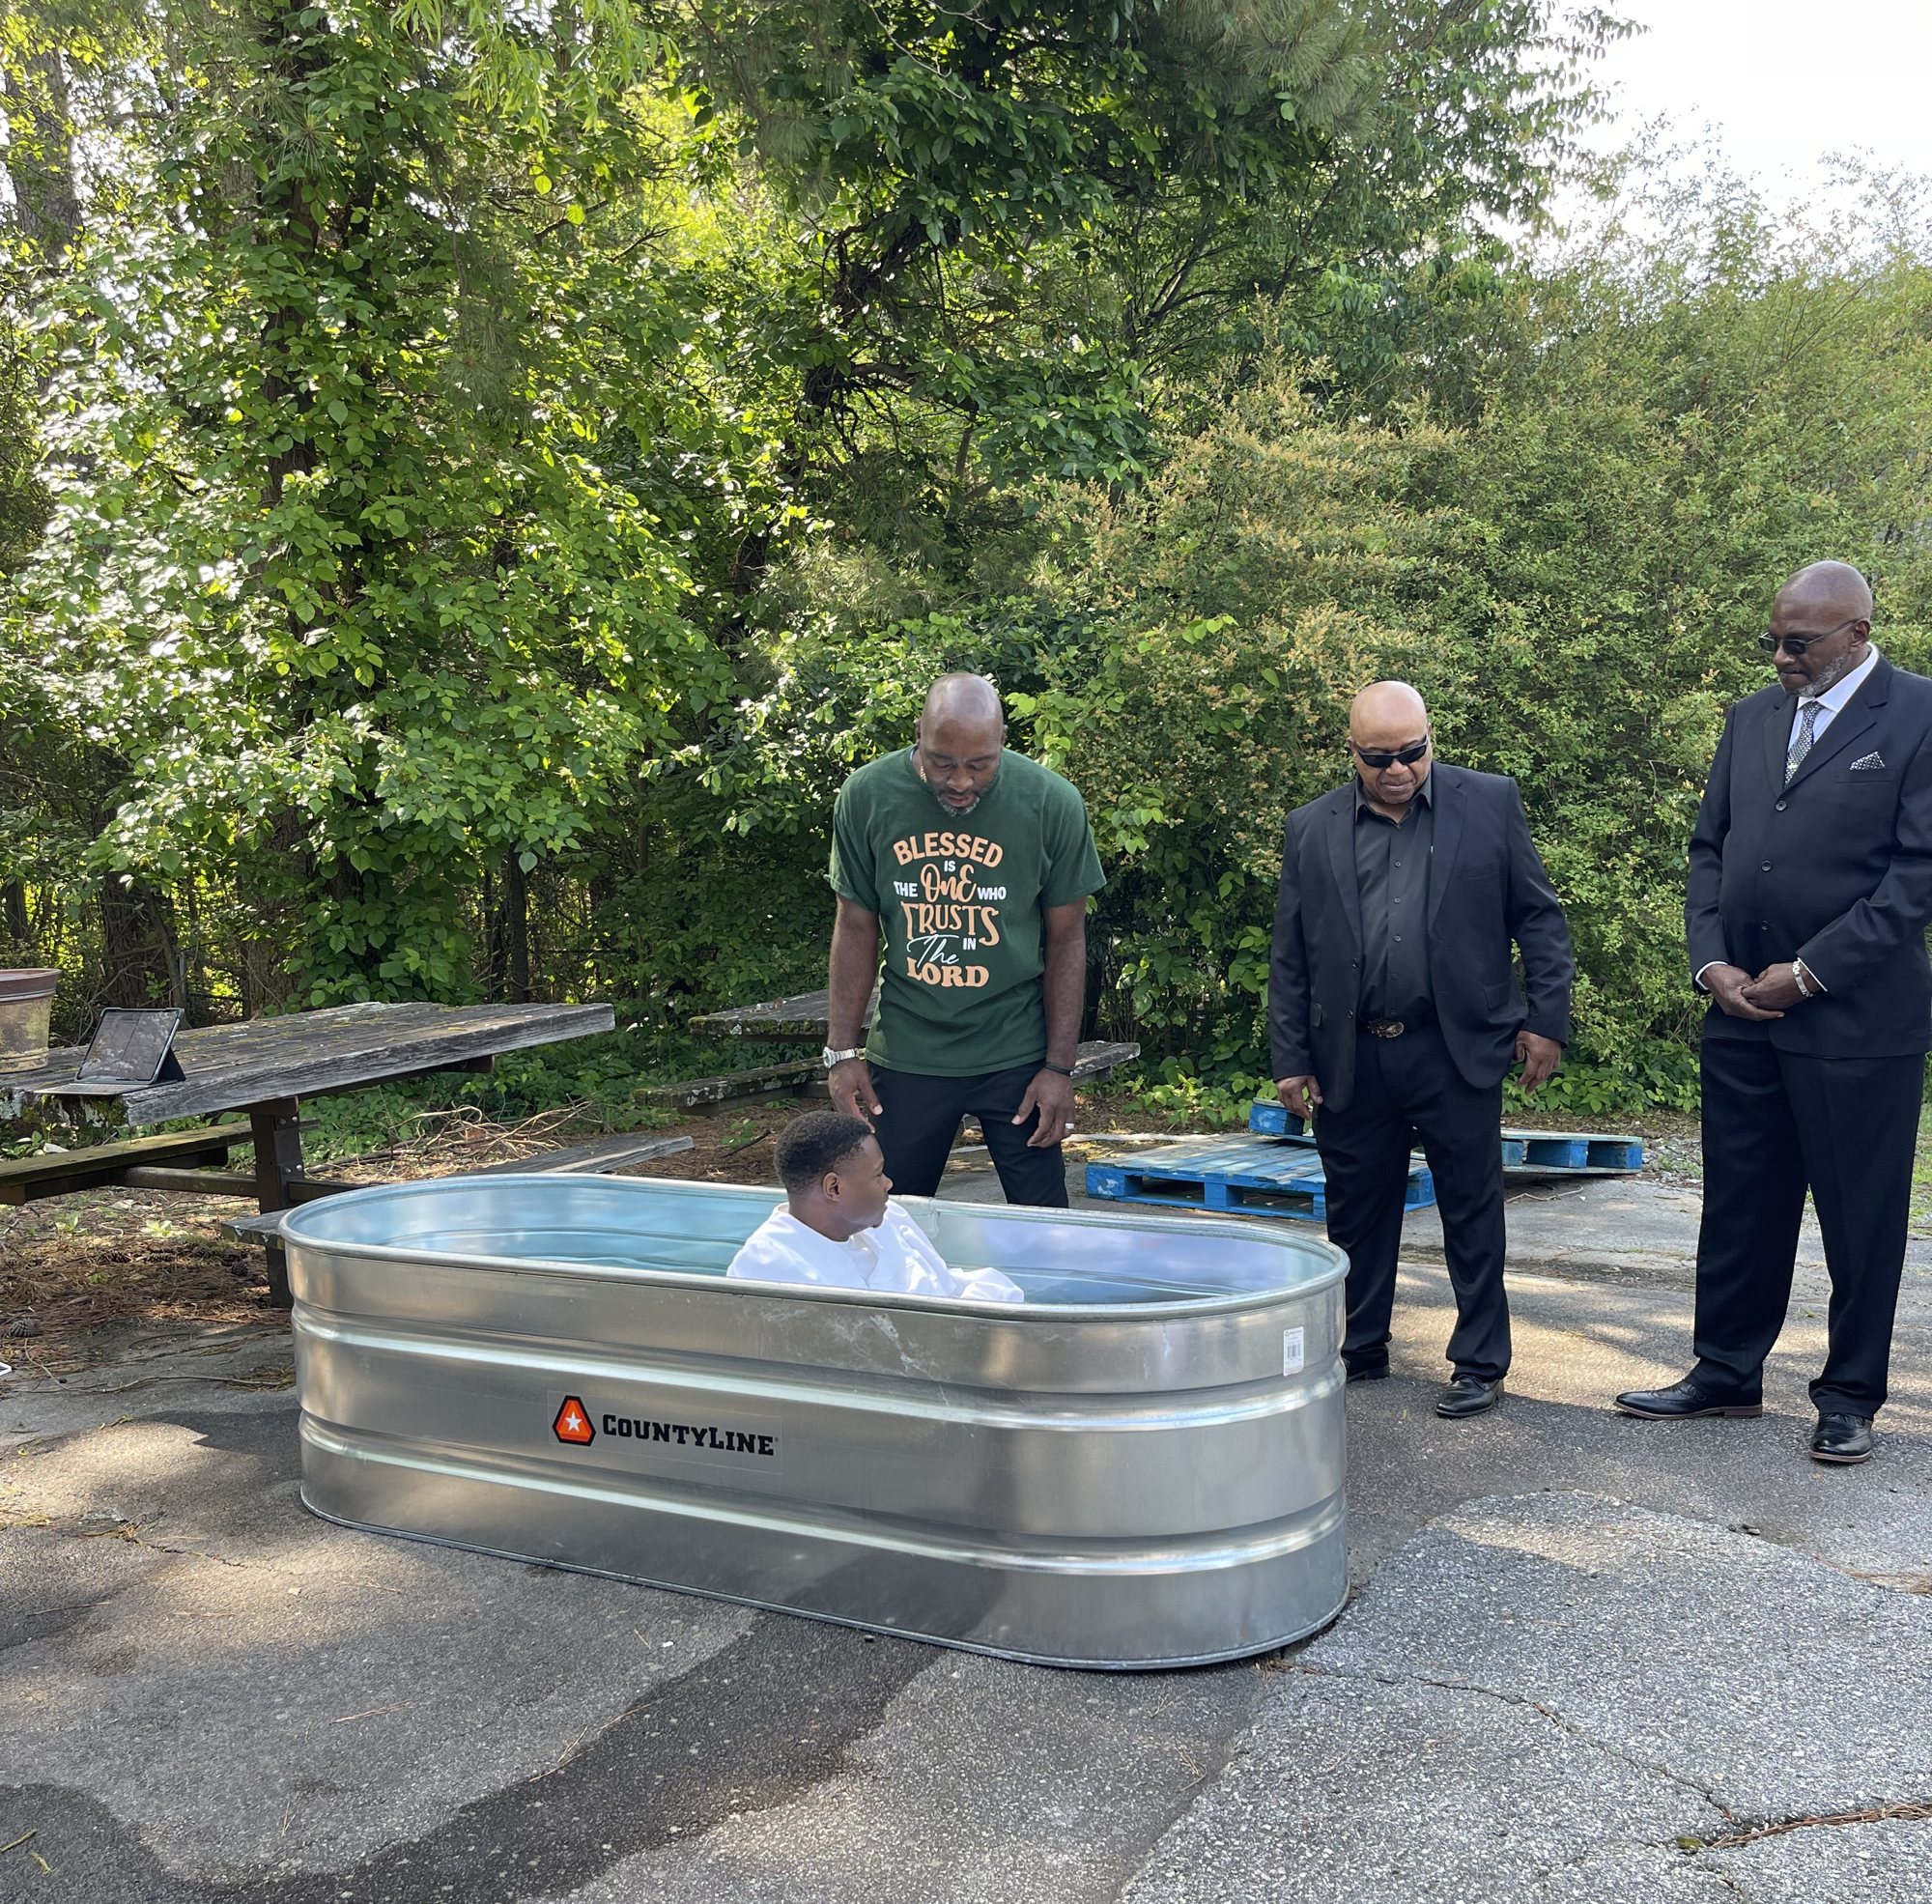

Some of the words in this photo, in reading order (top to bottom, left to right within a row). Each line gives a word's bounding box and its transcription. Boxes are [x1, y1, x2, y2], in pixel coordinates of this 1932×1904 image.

[893, 832, 1004, 868] BLESSED
[944, 860, 956, 872] IS
[893, 881, 919, 897] THE
[977, 886, 1007, 900] WHO
[900, 900, 1000, 947] TRUSTS
[906, 934, 960, 968] The
[962, 937, 977, 951] IN
[906, 956, 990, 987] LORD
